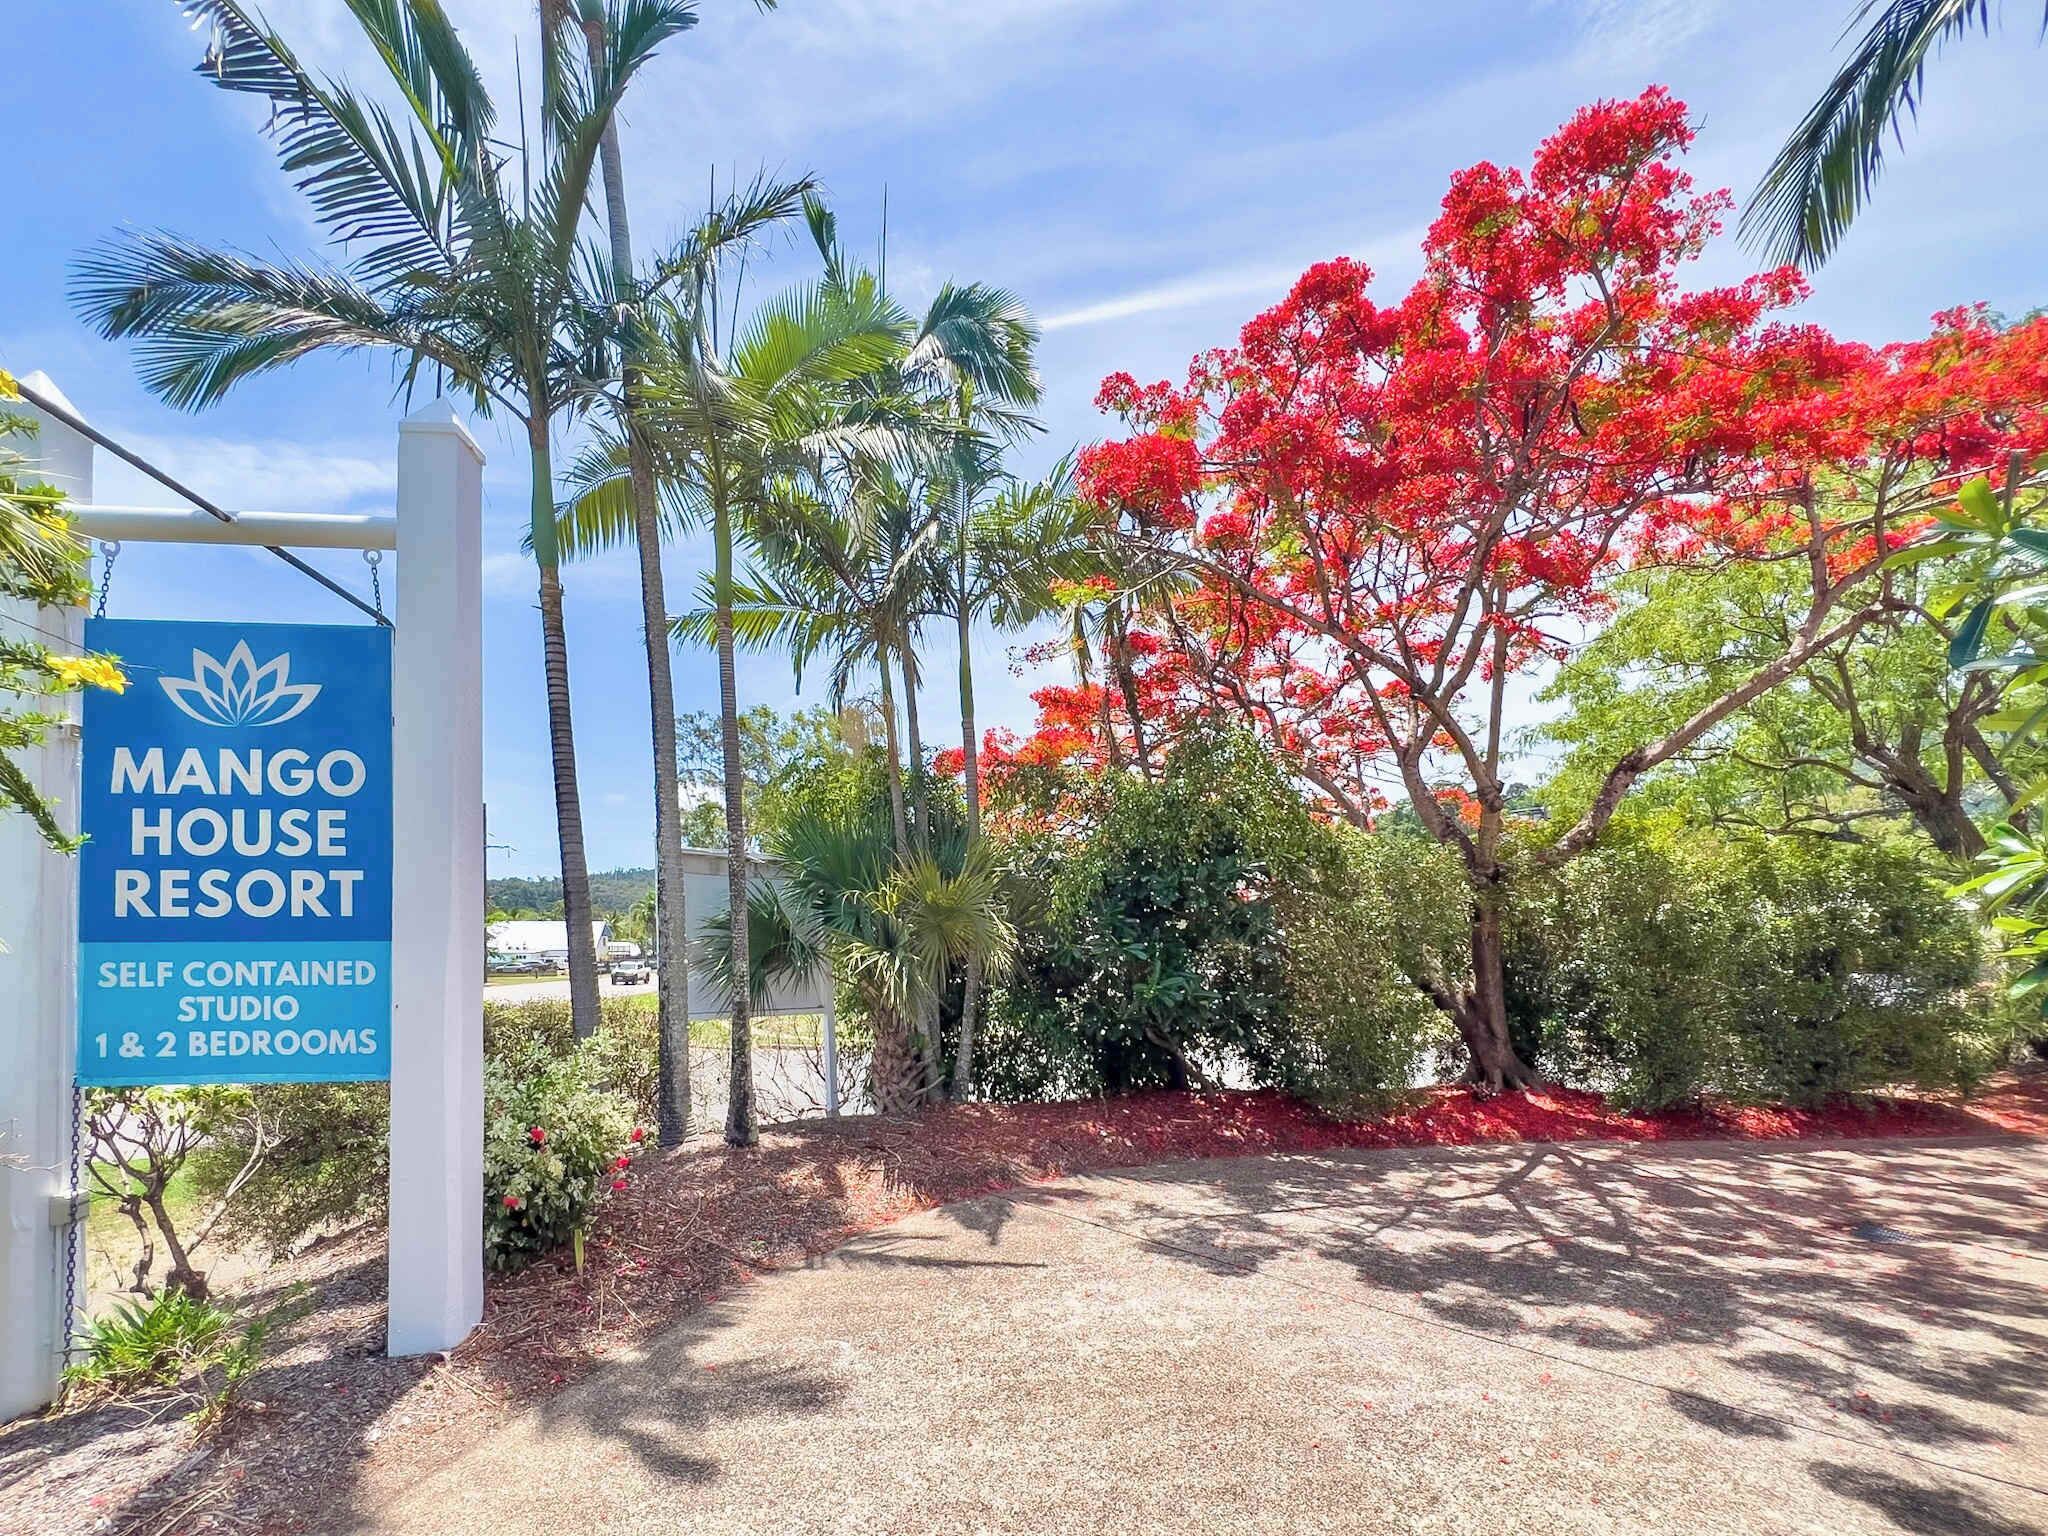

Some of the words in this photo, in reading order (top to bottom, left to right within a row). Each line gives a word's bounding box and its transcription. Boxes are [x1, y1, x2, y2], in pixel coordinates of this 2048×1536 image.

[110, 747, 367, 797] MANGO
[131, 807, 347, 857] HOUSE
[114, 869, 364, 918] RESORT
[98, 961, 174, 988] SELF
[182, 960, 376, 987] CONTAINED
[177, 995, 300, 1022] STUDIO
[95, 1032, 107, 1058] 1
[119, 1032, 145, 1058] &
[156, 1031, 177, 1057] 2
[187, 1029, 377, 1057] BEDROOMS
